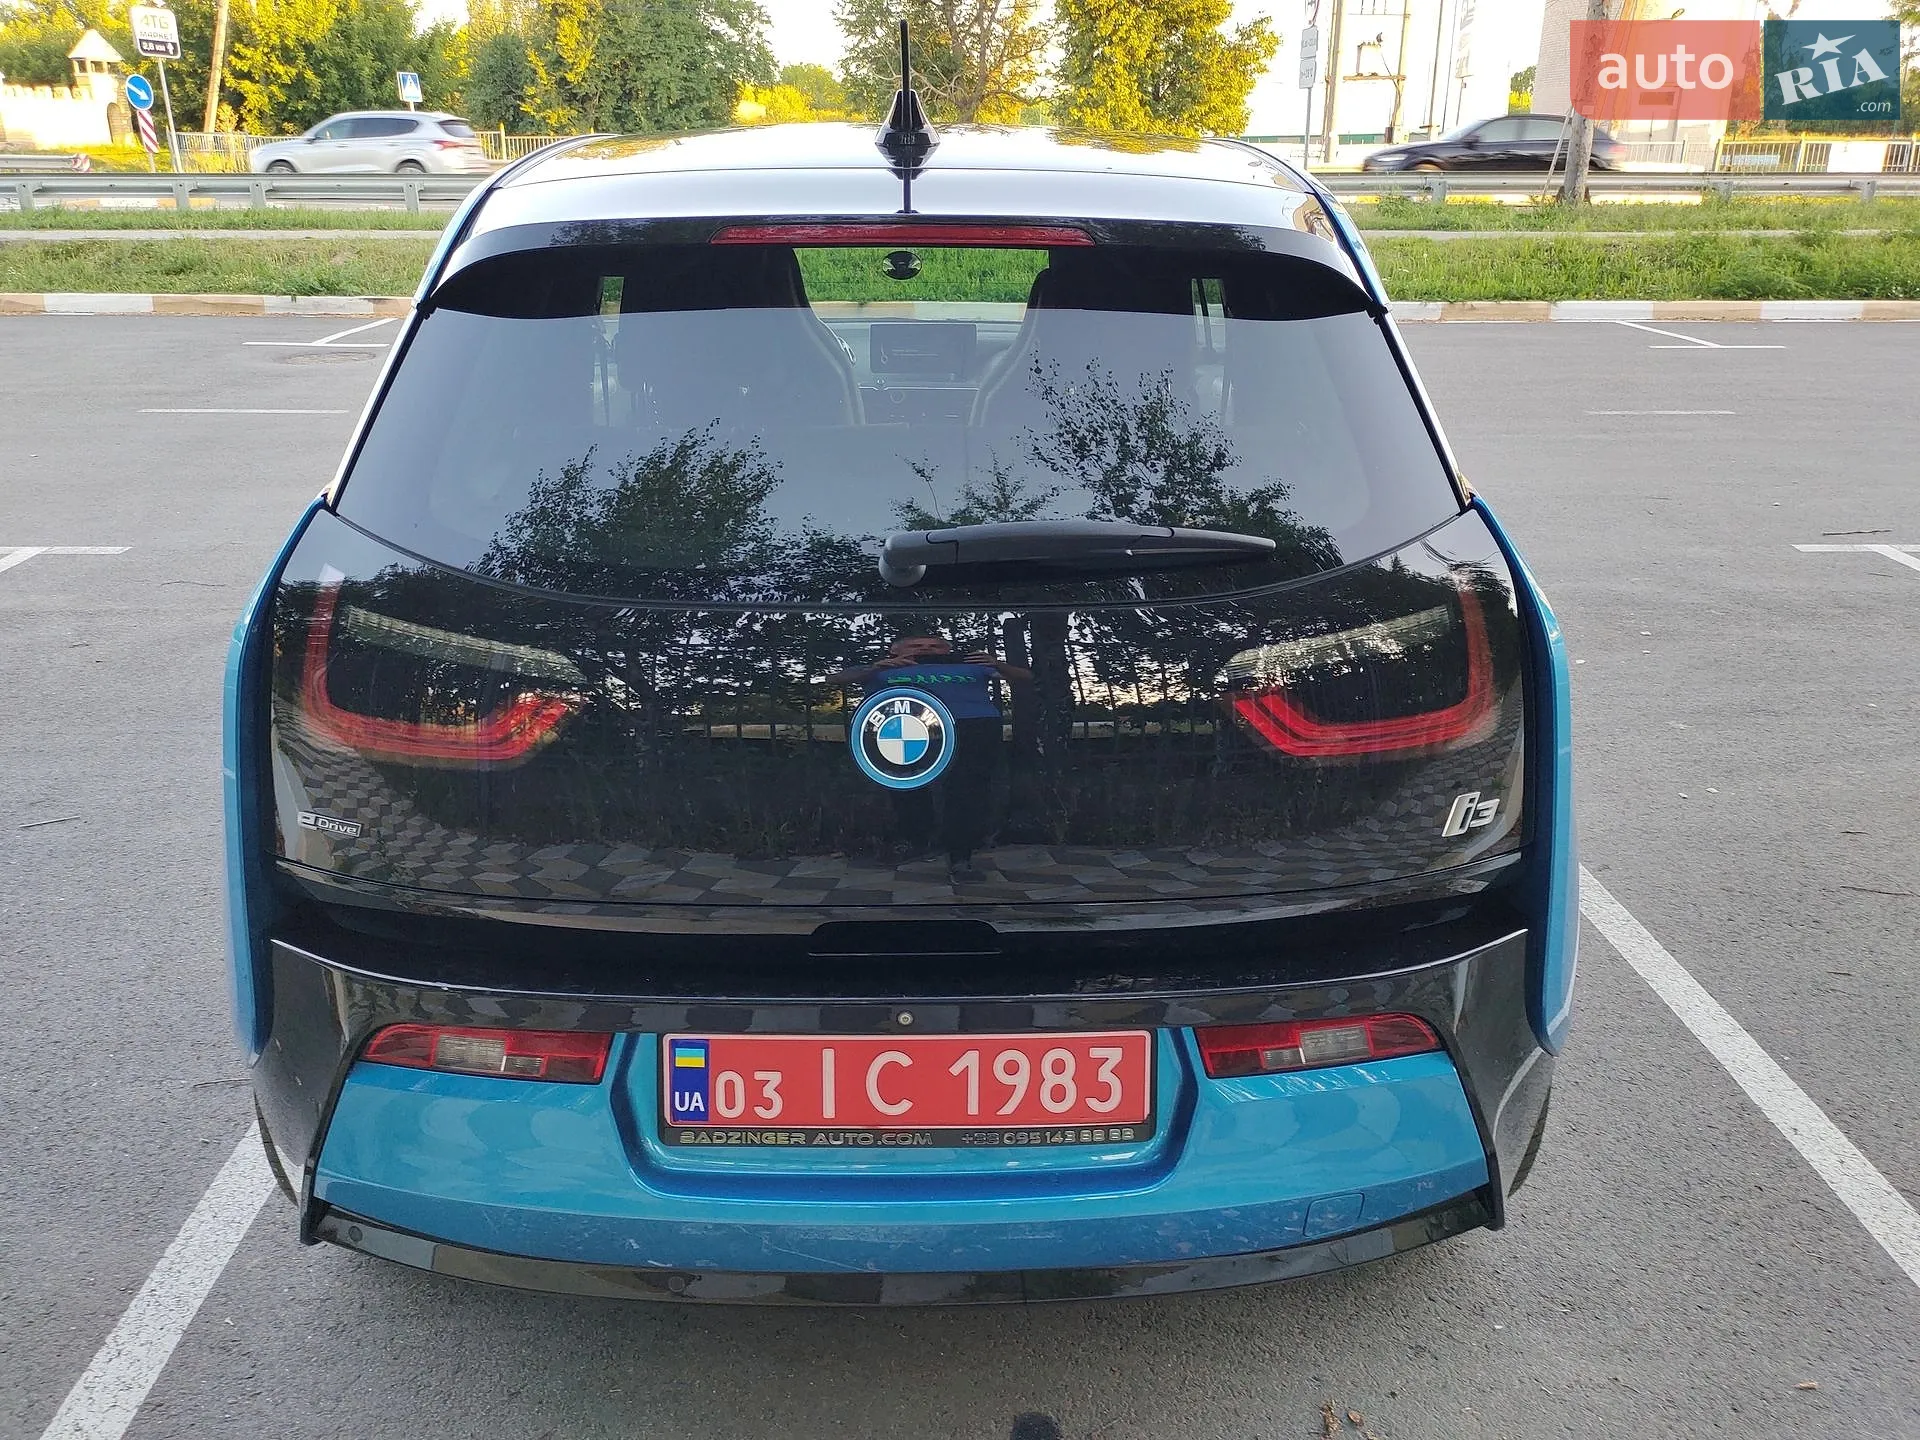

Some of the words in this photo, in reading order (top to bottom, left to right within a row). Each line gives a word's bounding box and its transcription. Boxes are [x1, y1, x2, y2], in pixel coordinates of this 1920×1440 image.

[869, 700, 938, 729] BMW
[1442, 792, 1500, 837] i3
[715, 1069, 784, 1120] 03
[948, 1047, 1124, 1116] 1983
[674, 1091, 705, 1112] UA
[679, 1131, 806, 1145] BADZINGER
